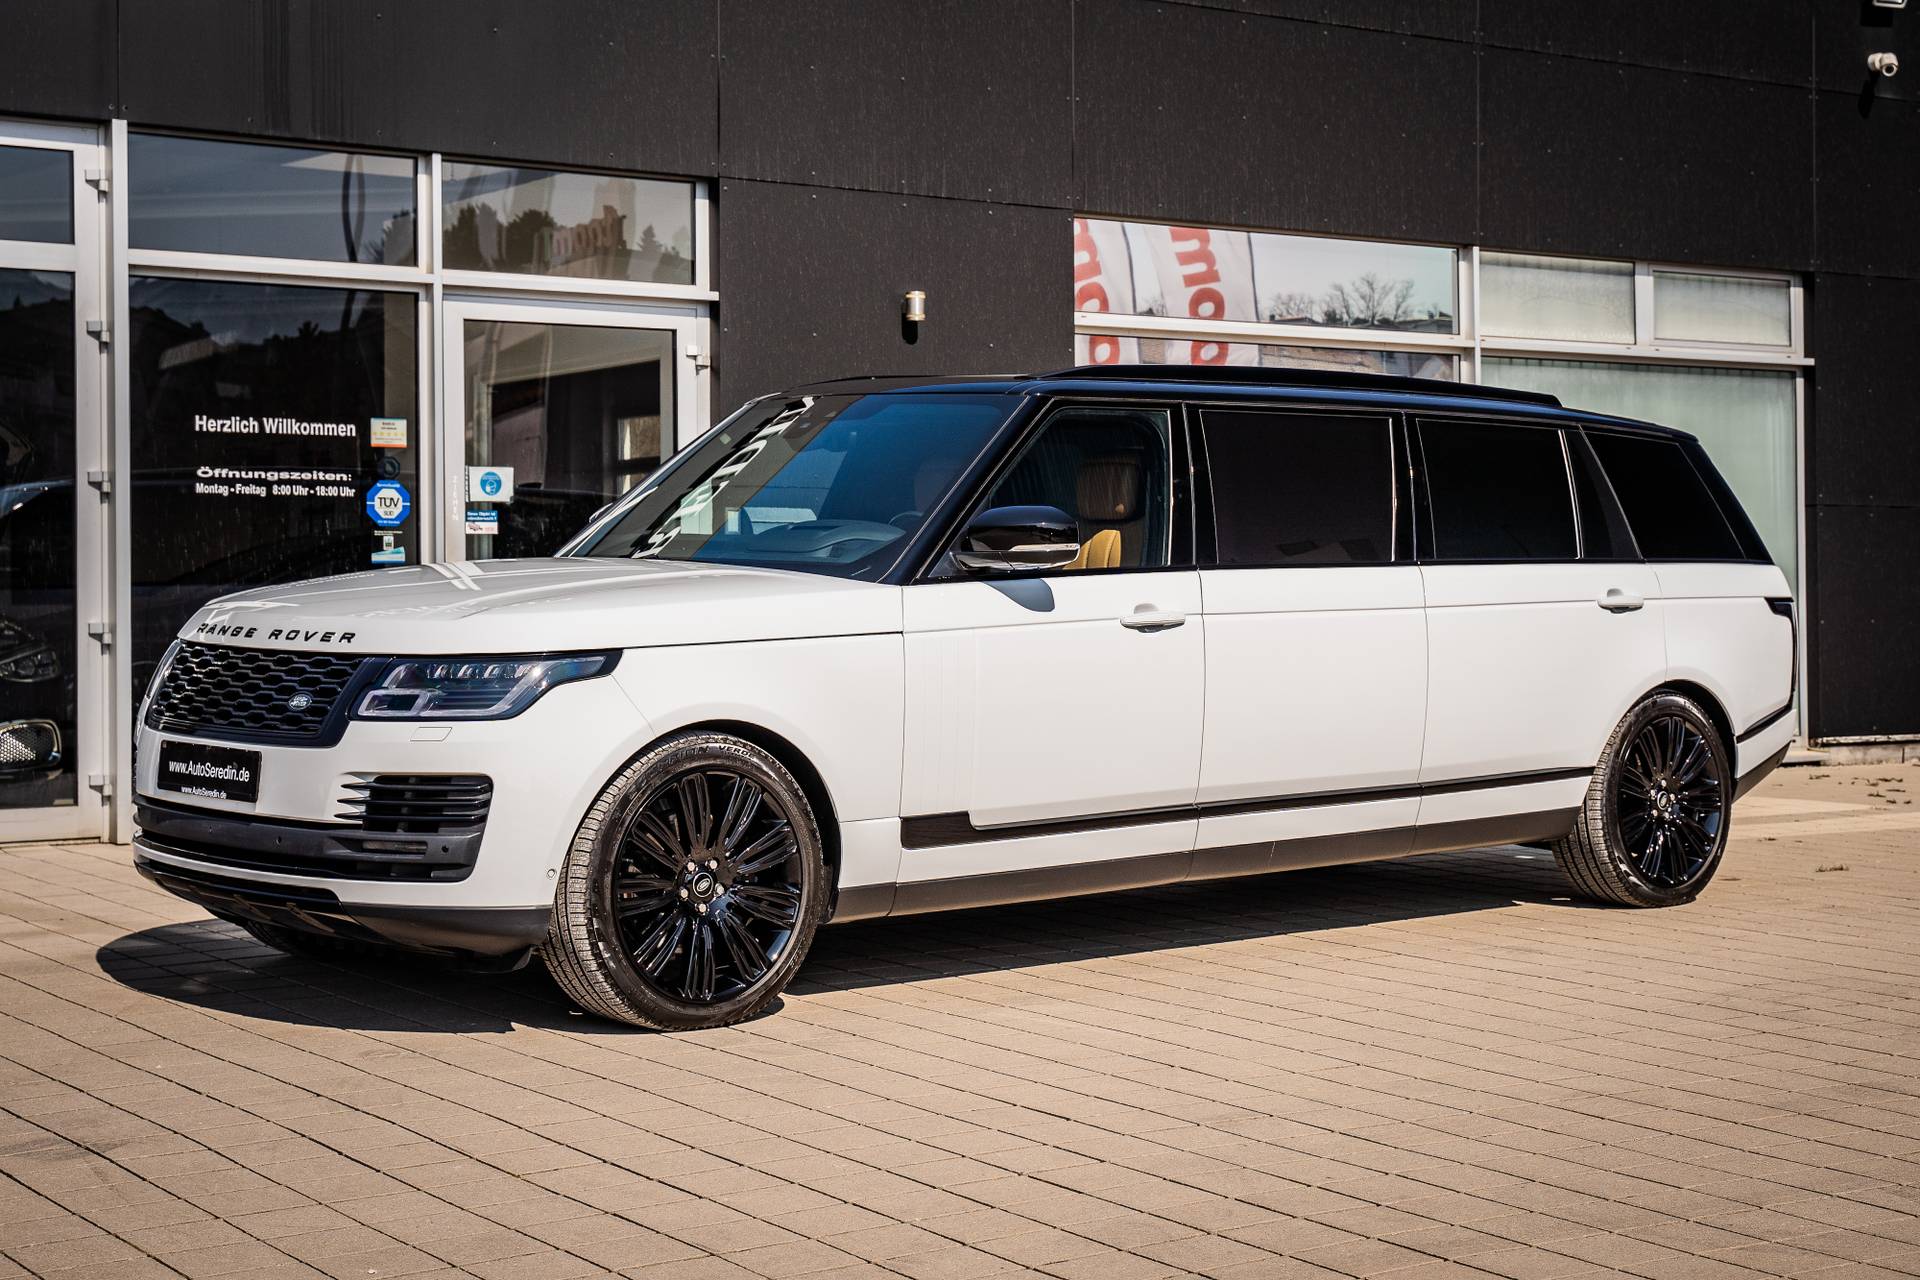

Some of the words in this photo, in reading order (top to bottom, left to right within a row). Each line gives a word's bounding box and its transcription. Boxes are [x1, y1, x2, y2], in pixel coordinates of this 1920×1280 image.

[194, 414, 259, 434] Herzlich
[263, 416, 356, 437] Willkommen
[196, 466, 352, 482] Öffnungszeiten:
[195, 483, 229, 497] Montag
[235, 483, 267, 497] Freitag
[272, 484, 291, 496] 8:00
[292, 484, 309, 496] Uhr
[315, 485, 338, 497] 18:00
[339, 486, 356, 497] Uhr
[377, 496, 400, 508] TÜV
[196, 622, 258, 638] RANGE
[268, 628, 356, 643] ROVER
[169, 760, 250, 782] www.AutoSeredin.de
[181, 786, 227, 800] www.AutoSeredin.de
